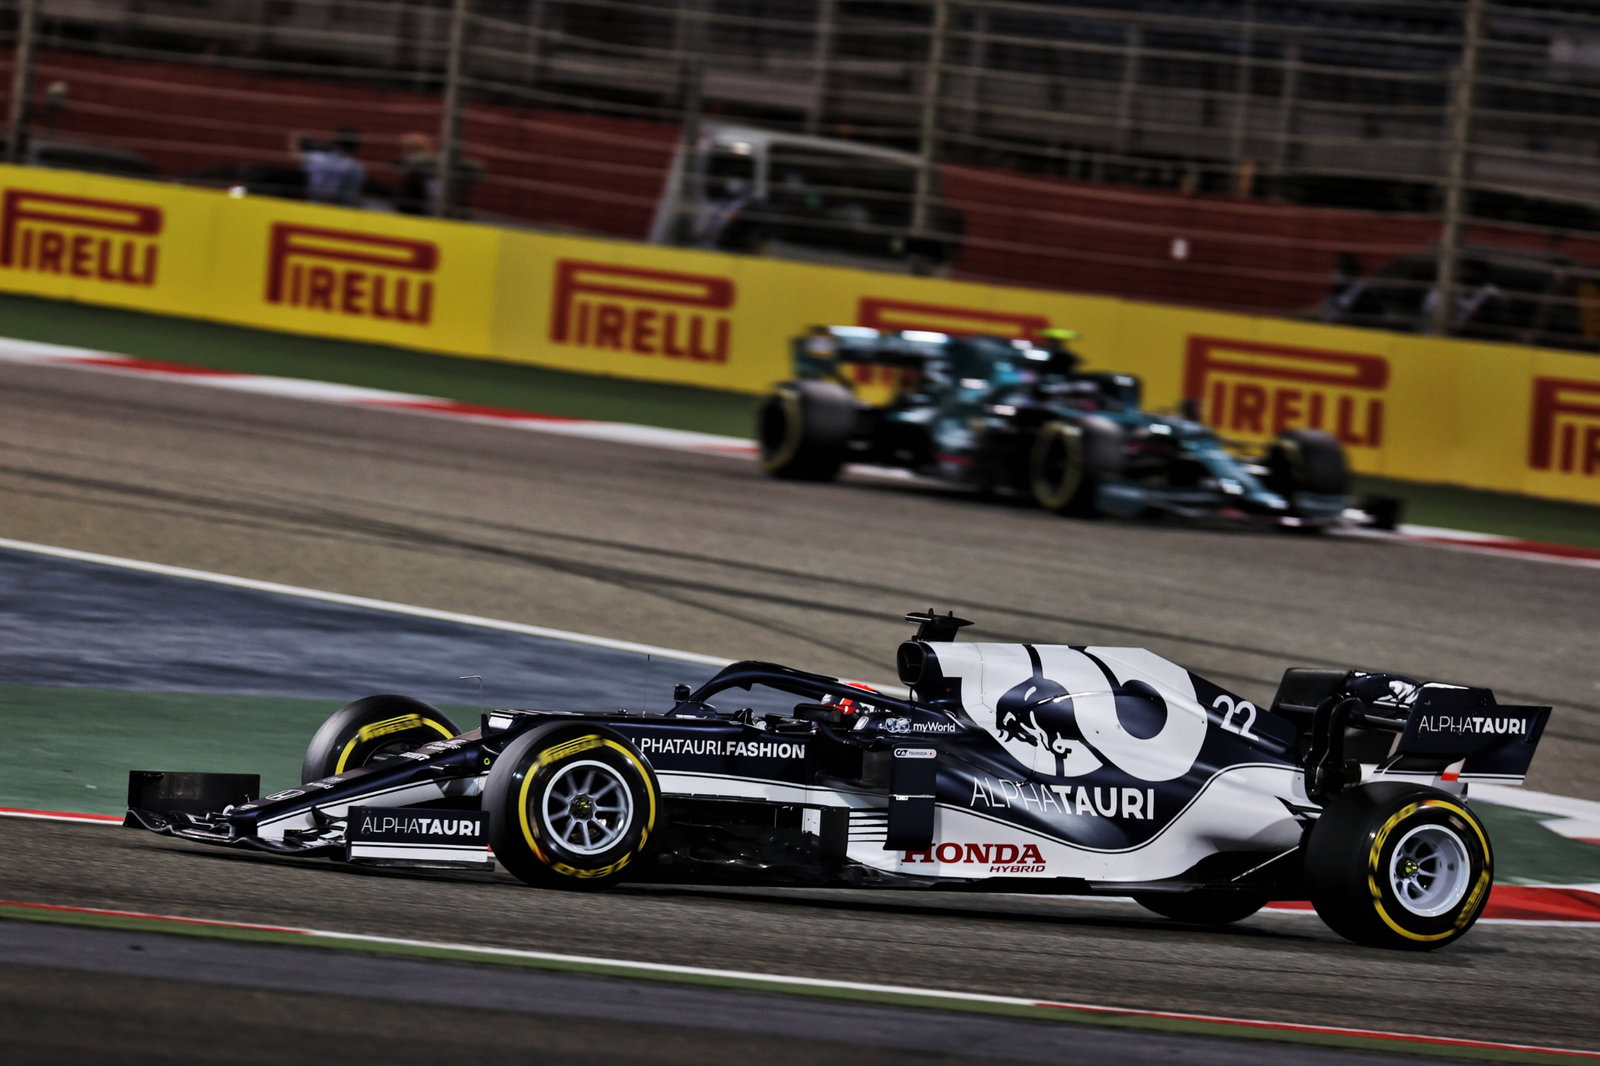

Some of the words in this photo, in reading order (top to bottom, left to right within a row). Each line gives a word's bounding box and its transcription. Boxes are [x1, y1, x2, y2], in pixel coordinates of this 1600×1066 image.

[0, 188, 163, 287] PIRELLI
[266, 222, 440, 325] PIRELLI
[549, 258, 736, 365] PIRELLI
[913, 721, 956, 733] myWorld
[1212, 694, 1260, 741] 22
[1418, 715, 1527, 735] ALPHATAURI
[970, 776, 1155, 820] ALPHATAURI
[361, 816, 481, 836] ALPHATAURI
[989, 865, 1046, 873] HYBRID
